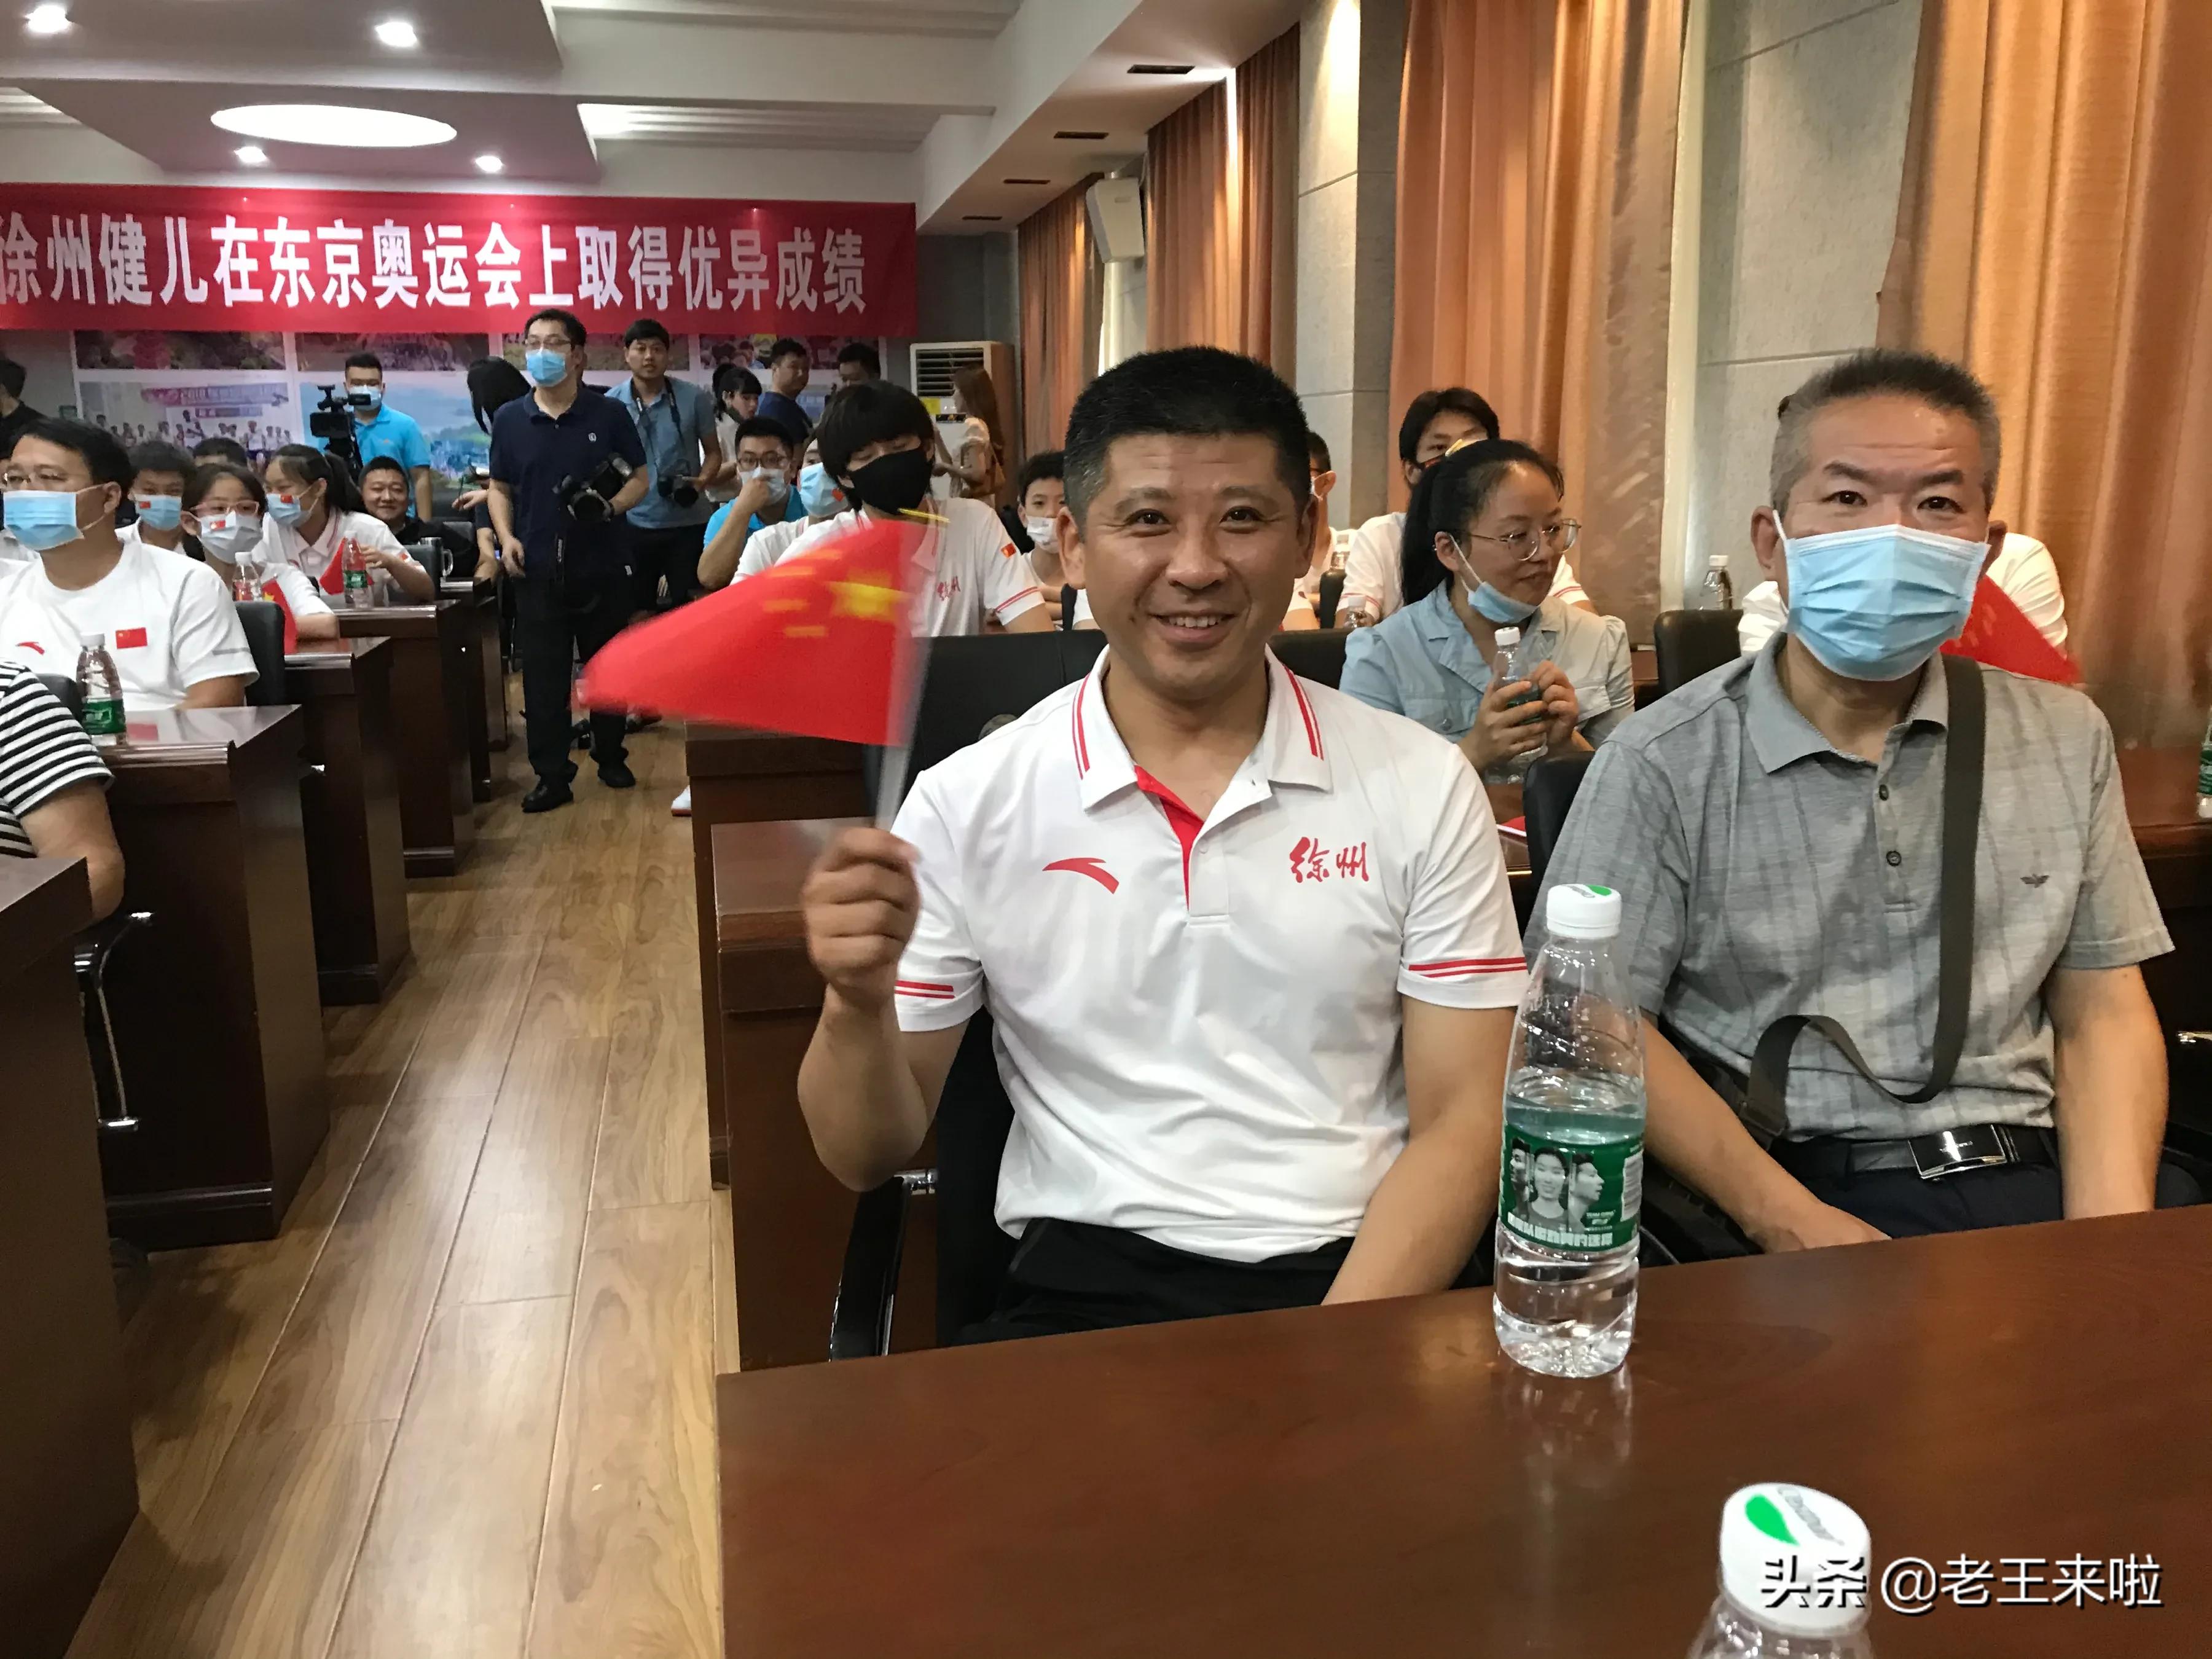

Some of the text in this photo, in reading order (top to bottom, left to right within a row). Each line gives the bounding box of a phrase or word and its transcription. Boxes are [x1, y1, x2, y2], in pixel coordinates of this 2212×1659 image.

[0, 211, 866, 314] 徐州健儿在东京奥运会上取得优异成绩
[1289, 836, 1369, 883] 徐州
